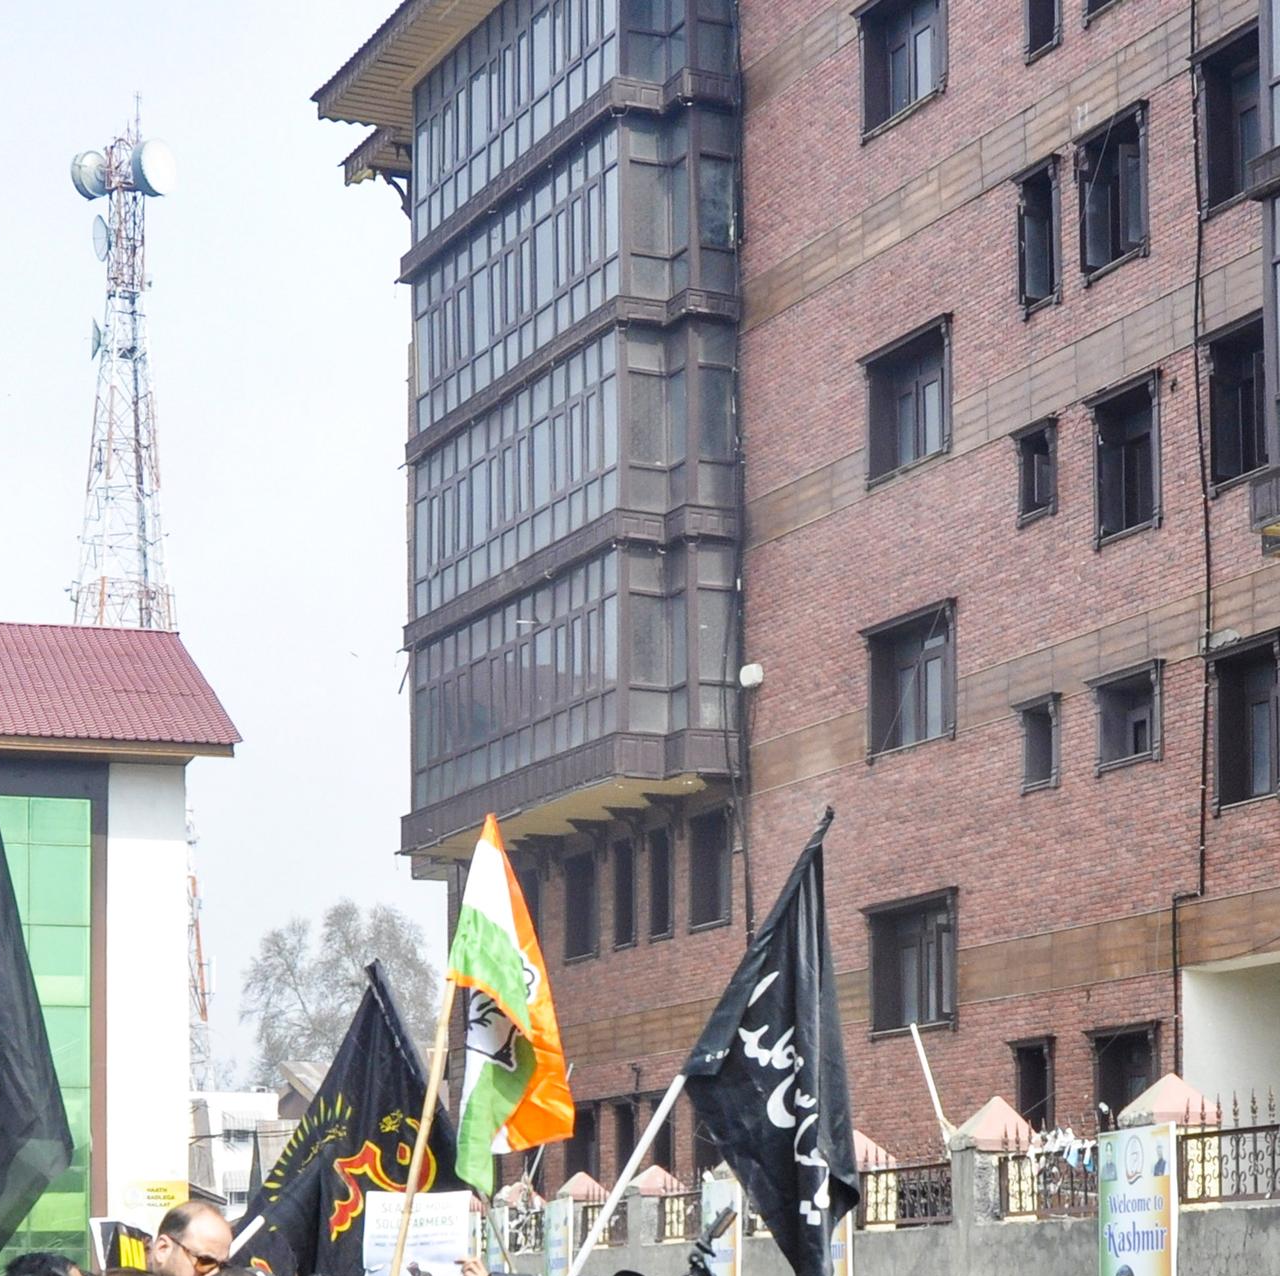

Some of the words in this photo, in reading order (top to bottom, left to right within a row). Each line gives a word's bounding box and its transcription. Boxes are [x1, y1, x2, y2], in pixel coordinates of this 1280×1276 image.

[1107, 1193, 1151, 1214] Welcome
[1154, 1195, 1164, 1211] to
[1104, 1221, 1167, 1258] Kashmir
